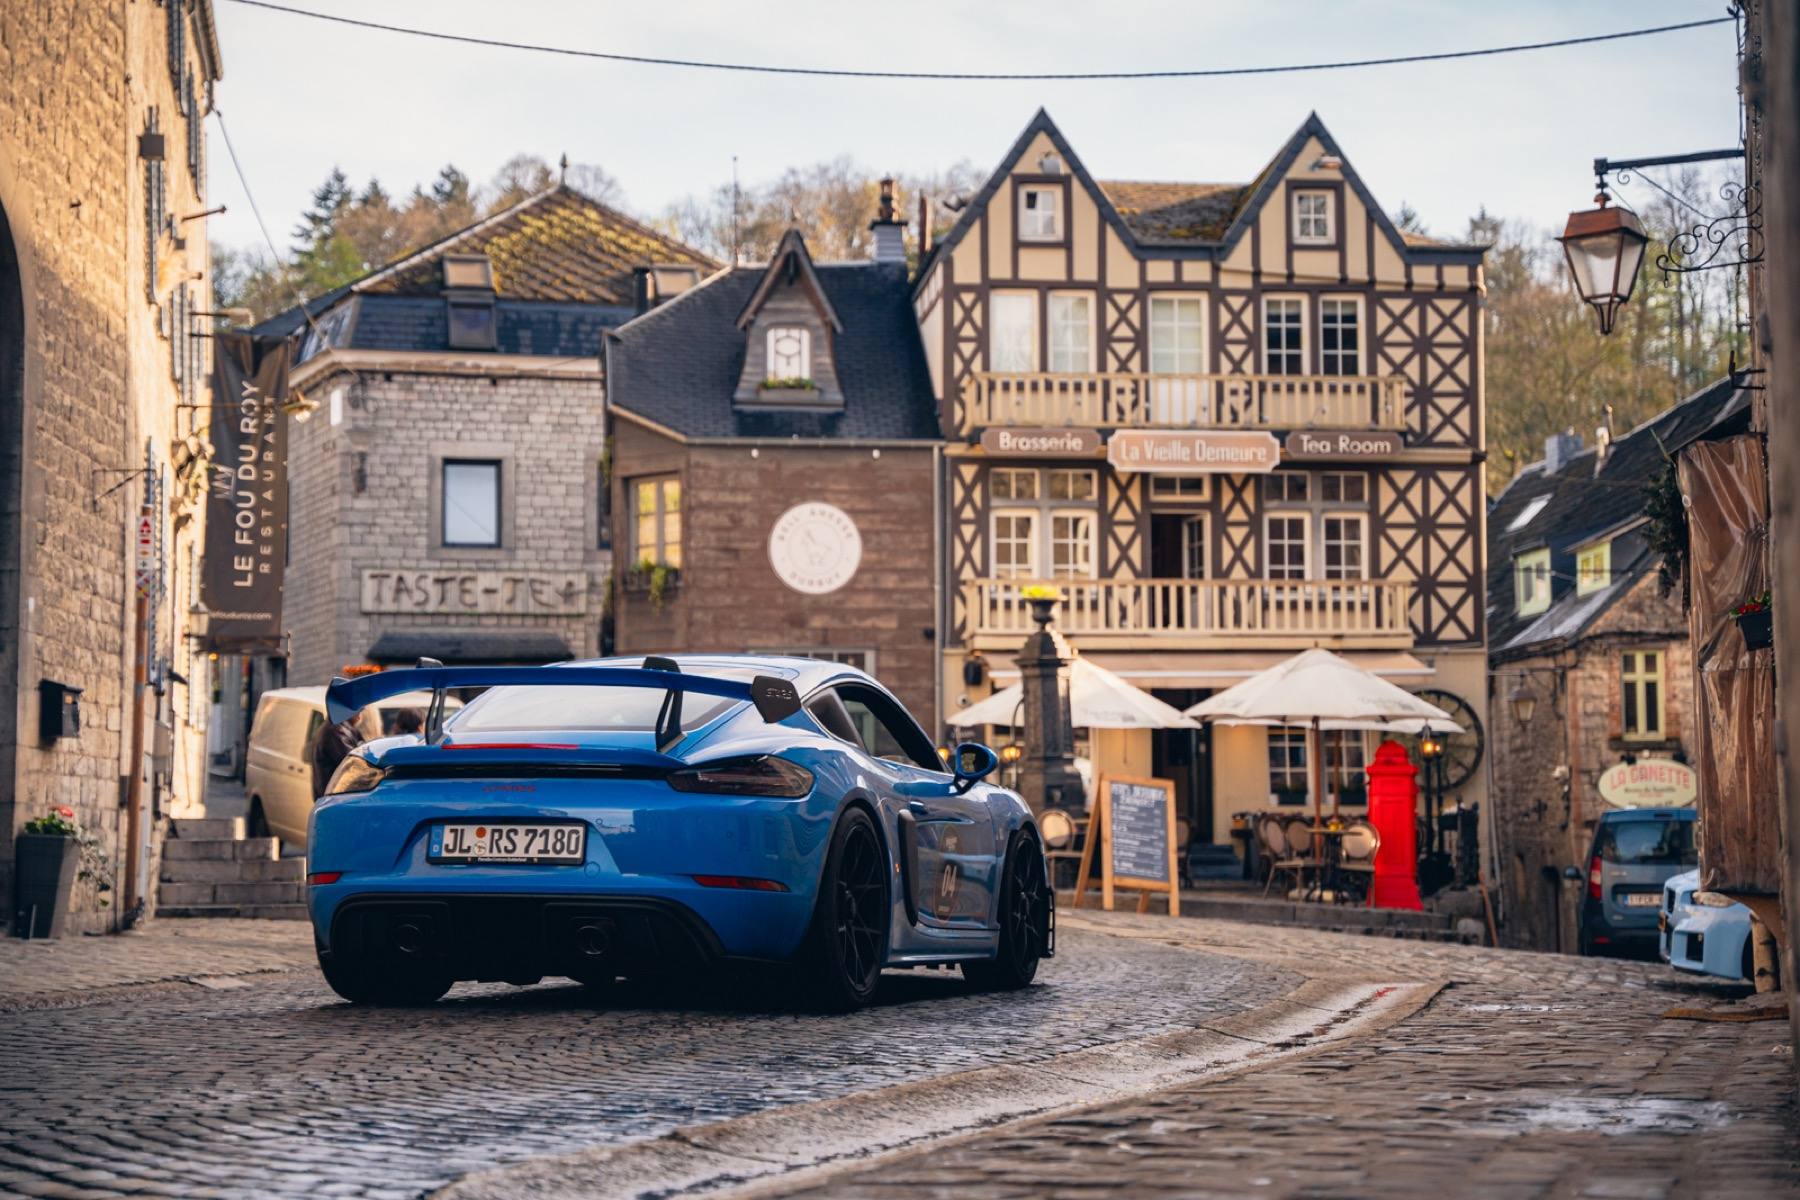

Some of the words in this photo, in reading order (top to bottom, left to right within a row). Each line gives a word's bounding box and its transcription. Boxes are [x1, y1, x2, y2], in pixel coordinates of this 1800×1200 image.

[240, 380, 262, 434] ROY
[999, 431, 1083, 452] Brasserie
[1120, 440, 1140, 460] La
[1143, 440, 1192, 462] Vieille
[1194, 439, 1267, 463] Demeure
[1300, 434, 1331, 453] Tea
[1338, 435, 1392, 455] Room
[237, 444, 259, 481] DU
[259, 395, 277, 574] RESTAURANT
[235, 491, 256, 545] FOU
[233, 555, 254, 587] LE
[1610, 767, 1627, 790] LA
[444, 828, 472, 854] JL
[489, 828, 519, 854] RS
[524, 828, 581, 856] 7180
[941, 864, 957, 898] 04
